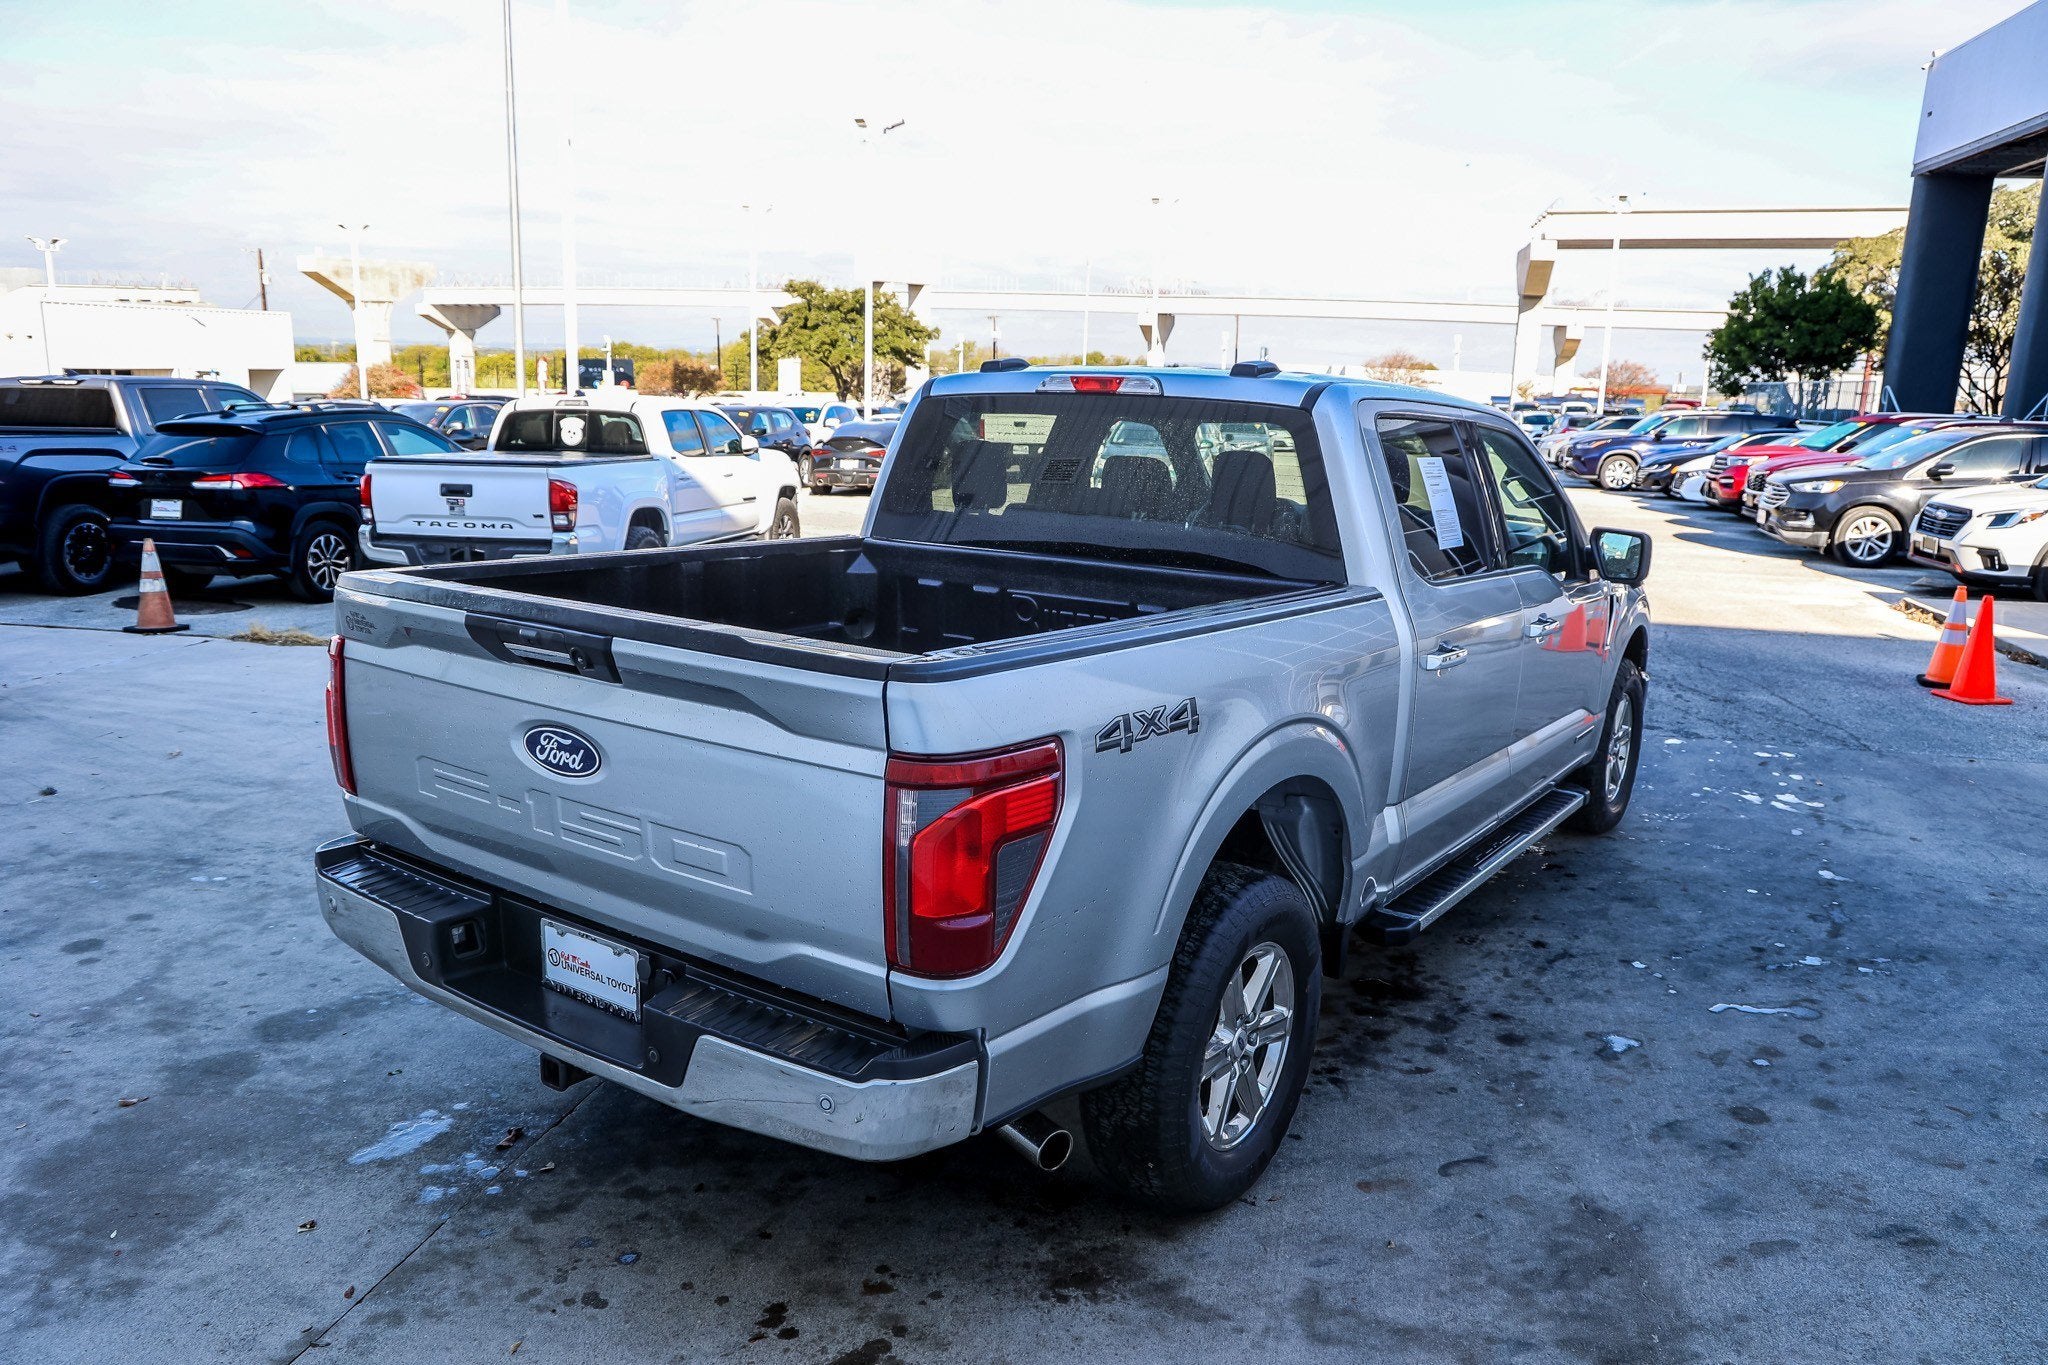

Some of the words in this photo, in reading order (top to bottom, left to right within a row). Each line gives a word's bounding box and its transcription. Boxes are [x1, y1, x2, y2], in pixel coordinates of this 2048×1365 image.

[413, 520, 514, 530] TACOMA
[536, 732, 584, 770] Ford
[416, 755, 753, 896] F-150
[561, 961, 606, 984] UNIVERSAL
[606, 977, 637, 995] TOYOTA
